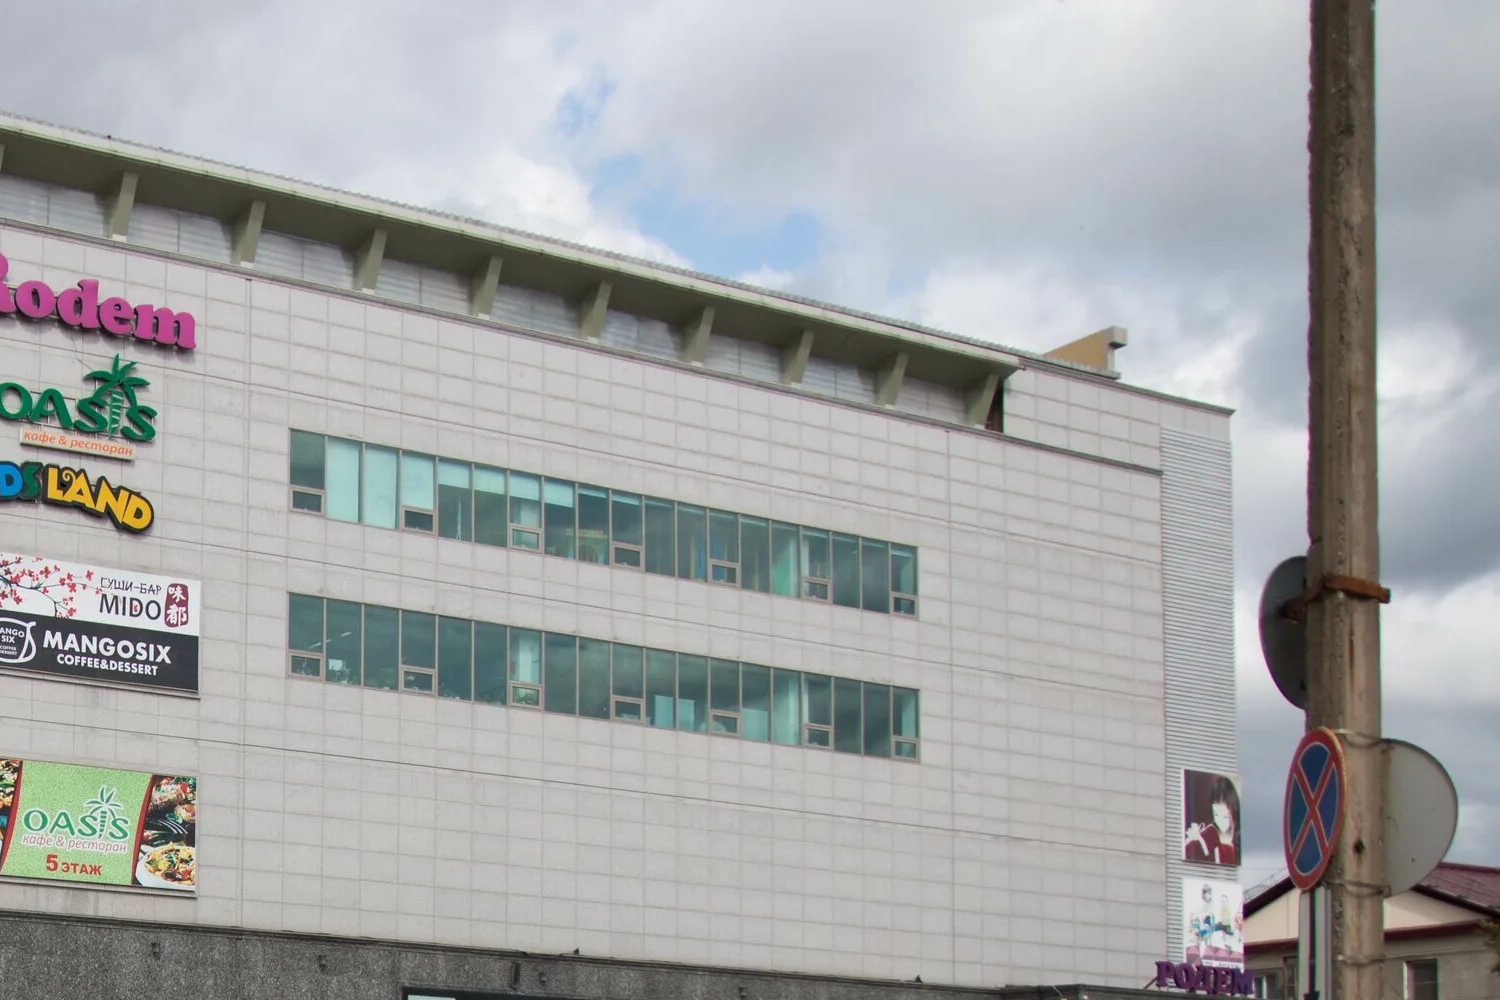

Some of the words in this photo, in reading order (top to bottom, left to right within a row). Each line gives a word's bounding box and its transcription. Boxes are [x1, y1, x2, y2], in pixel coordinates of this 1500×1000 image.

[24, 430, 56, 444] кафе
[58, 435, 67, 445] &
[70, 438, 133, 456] ресторан
[45, 464, 155, 533] LAND
[100, 577, 162, 596] СУШИ-БАР
[99, 593, 162, 620] MIDO
[1, 635, 15, 643] SIX
[43, 630, 172, 664] MANGOSIX
[57, 653, 159, 676] COFFEE&DESSERT
[23, 809, 129, 841] OASIS
[22, 834, 53, 848] кафе
[56, 836, 65, 847] &
[67, 839, 127, 853] ресторан
[45, 854, 59, 872] 5
[61, 862, 102, 876] ЭТАЖ
[1155, 960, 1255, 996] РОДЕМ
